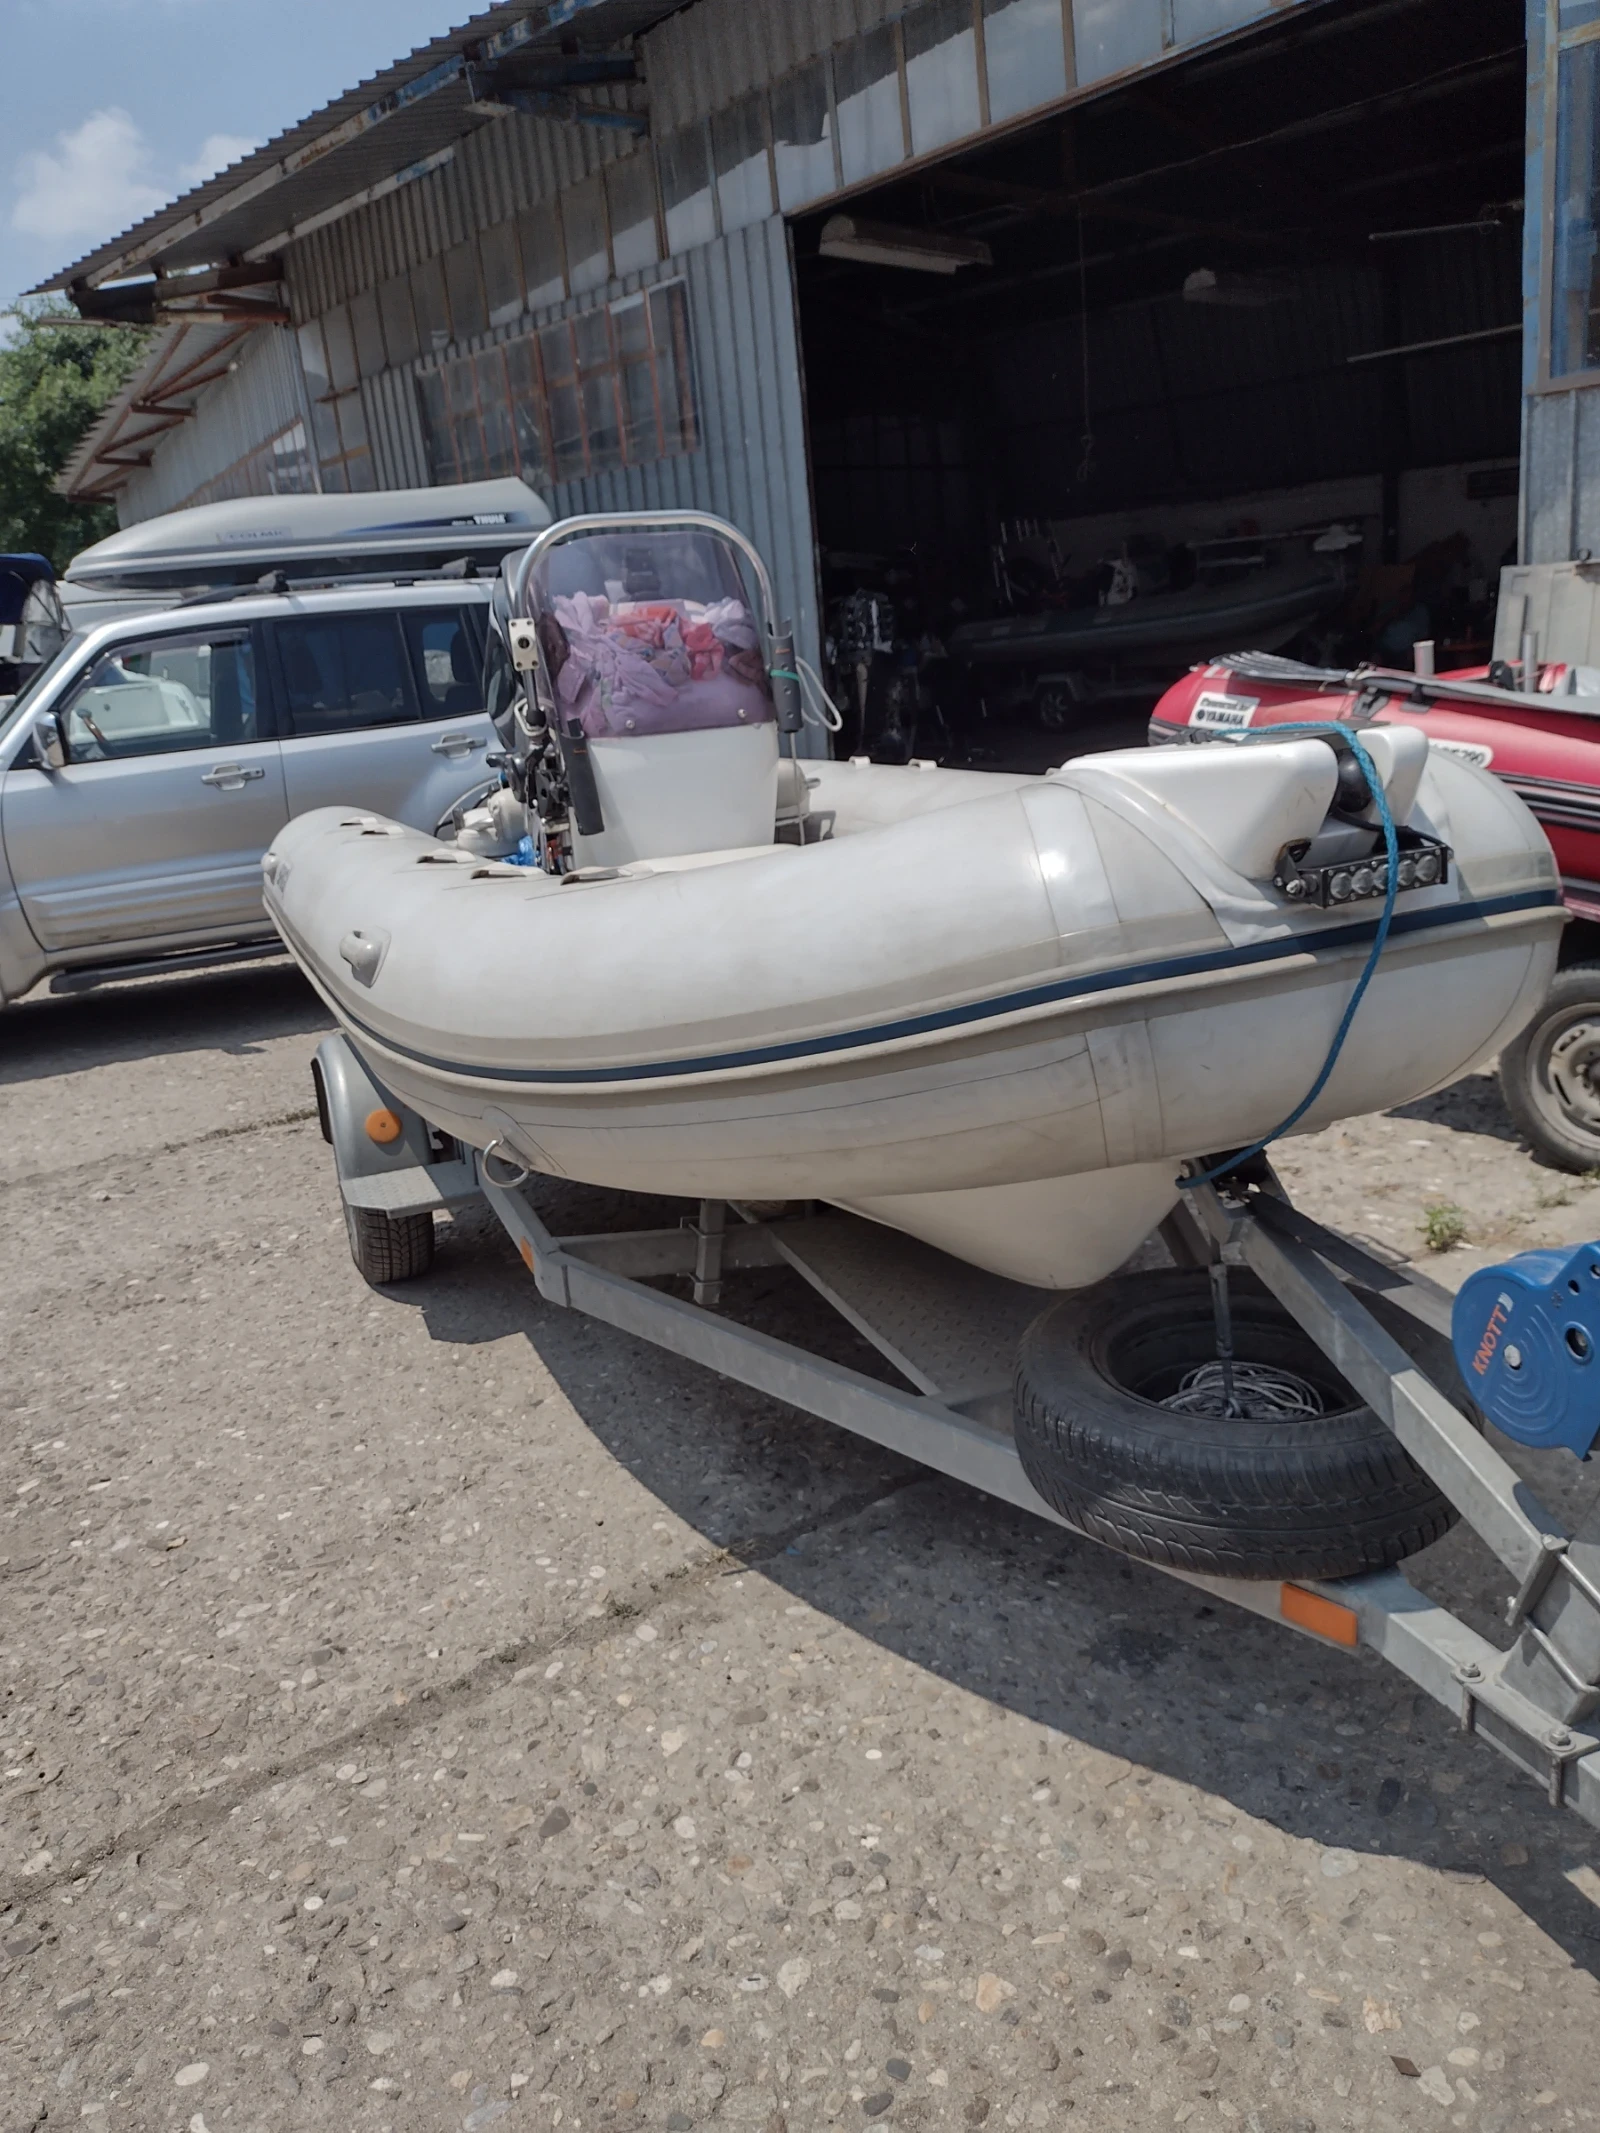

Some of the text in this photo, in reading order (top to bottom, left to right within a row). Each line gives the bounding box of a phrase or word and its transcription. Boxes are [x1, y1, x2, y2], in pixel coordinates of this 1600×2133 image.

[473, 513, 506, 525] THULE
[1206, 711, 1244, 724] YAMAHA
[1472, 1303, 1507, 1375] KNOTT
